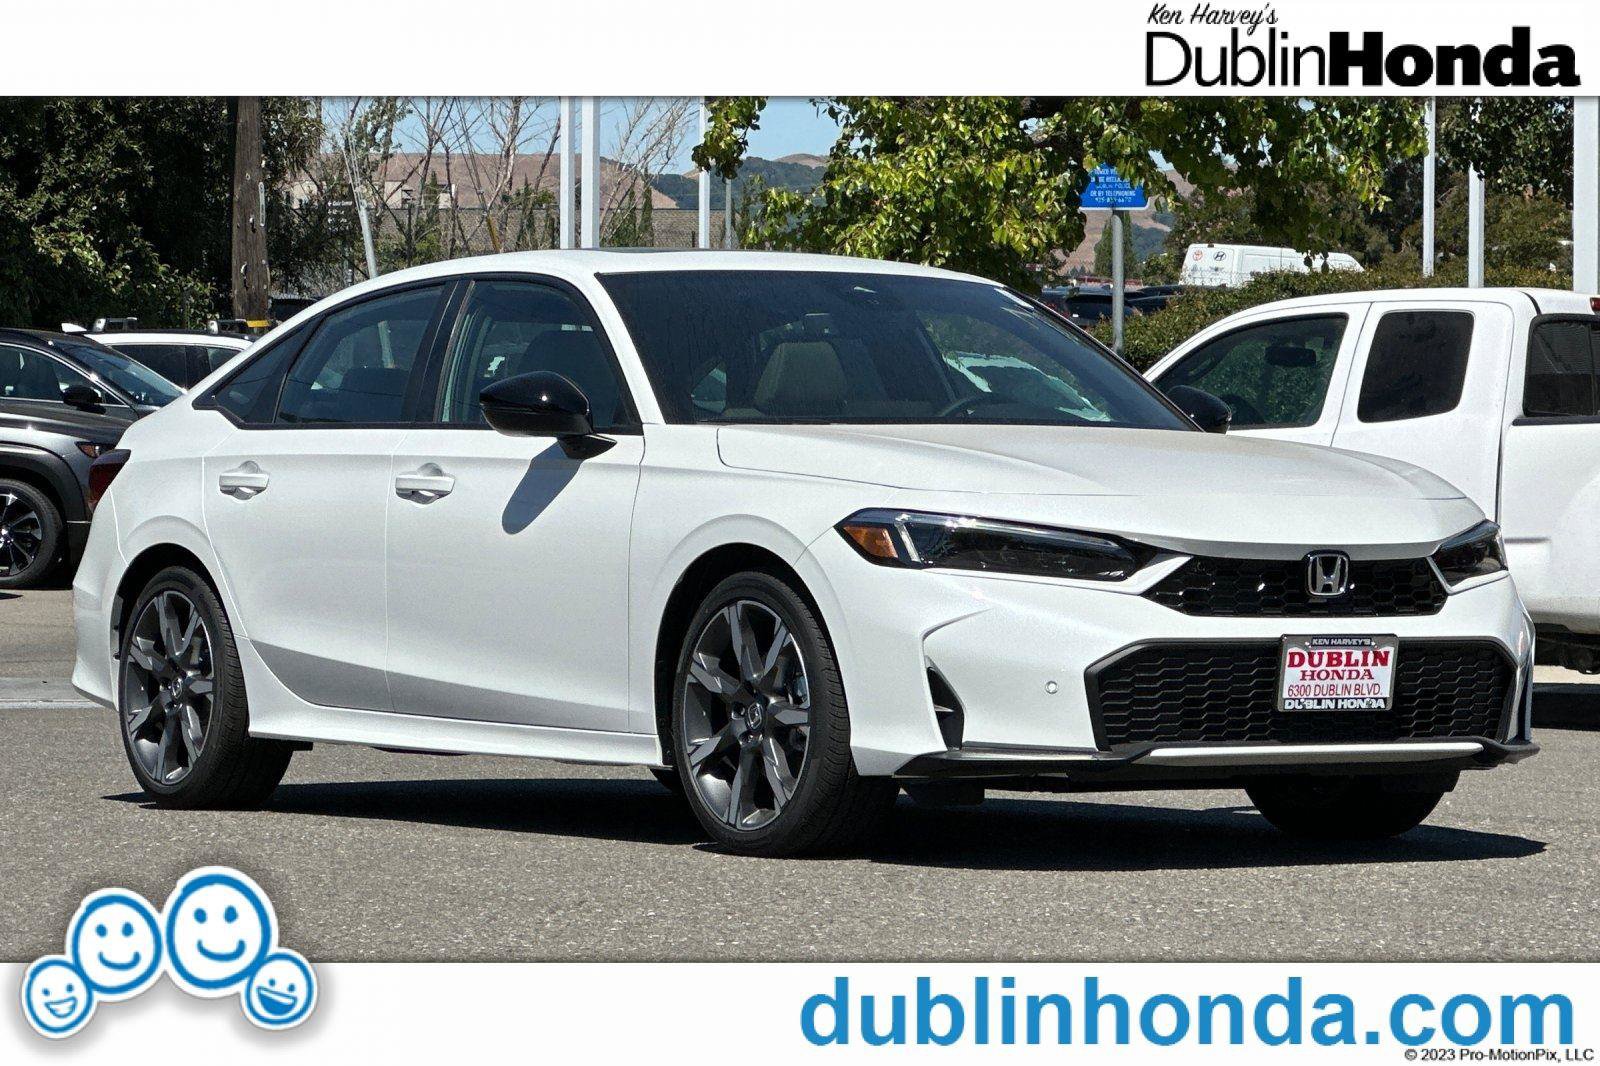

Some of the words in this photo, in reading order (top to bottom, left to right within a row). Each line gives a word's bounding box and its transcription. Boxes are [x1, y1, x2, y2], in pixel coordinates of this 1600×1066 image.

[1312, 638, 1330, 646] KEN
[1287, 650, 1390, 668] DUBLIN
[1300, 668, 1375, 681] HONDA
[1288, 684, 1312, 697] 6300
[1313, 683, 1352, 697] DUBLIN
[1284, 698, 1336, 710] DUBLIN
[1337, 698, 1386, 709] HONDA
